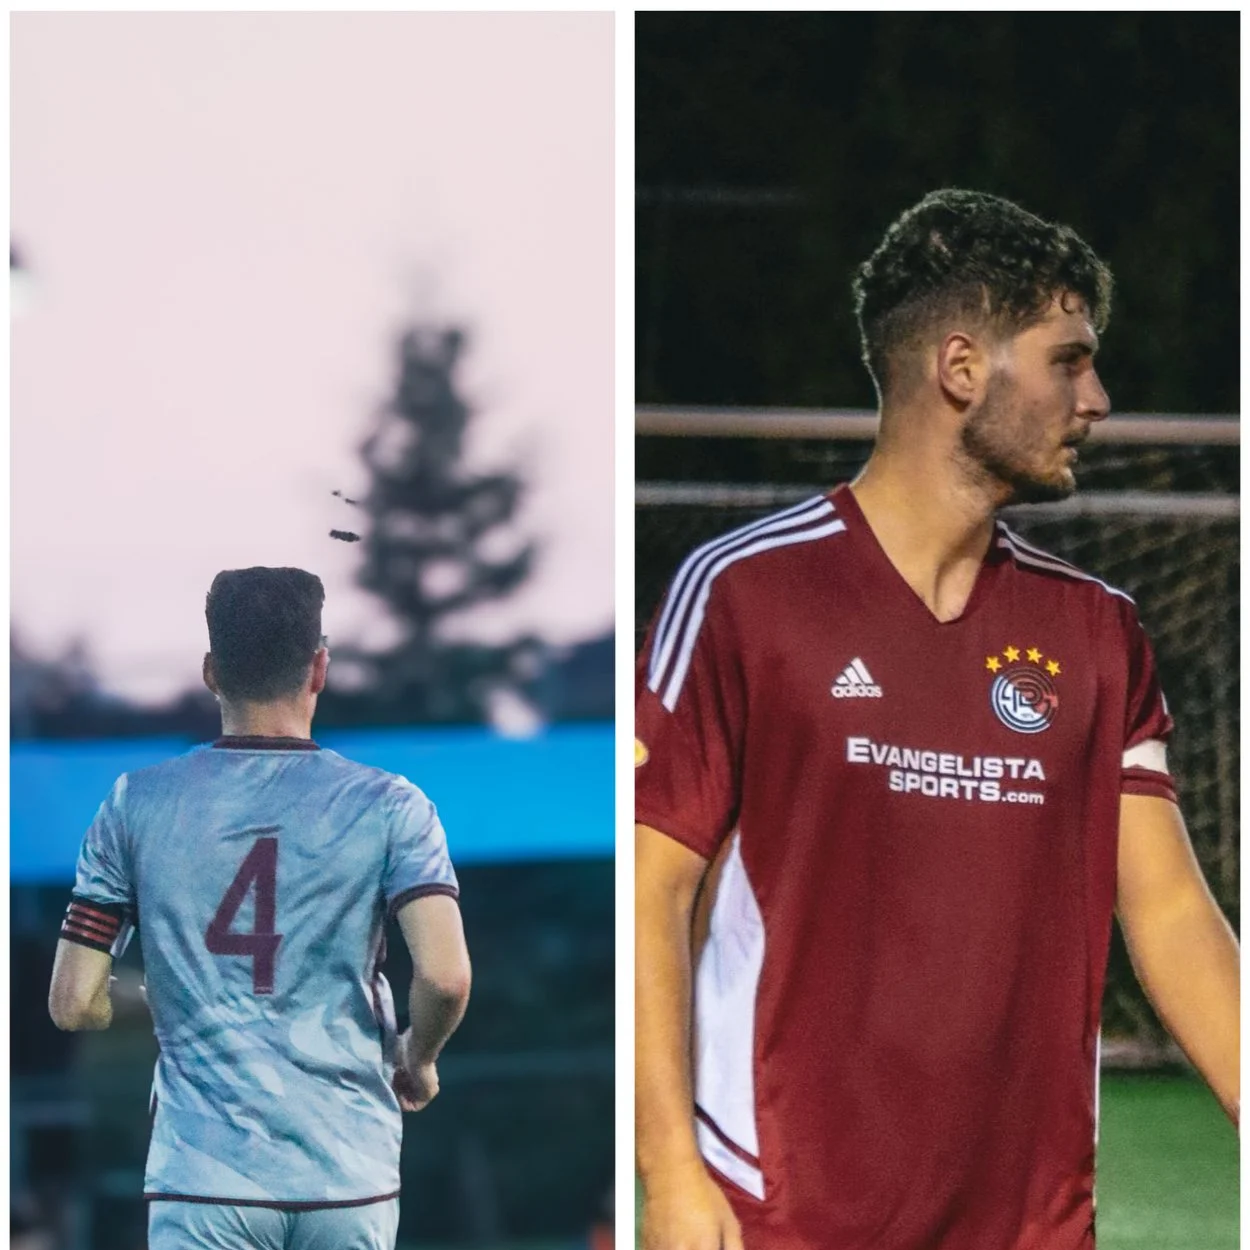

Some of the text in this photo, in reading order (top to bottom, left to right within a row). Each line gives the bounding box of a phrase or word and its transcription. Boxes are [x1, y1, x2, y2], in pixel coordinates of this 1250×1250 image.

[831, 685, 882, 698] adidas
[889, 770, 1045, 805] SPORTS.com
[205, 837, 284, 994] 4
